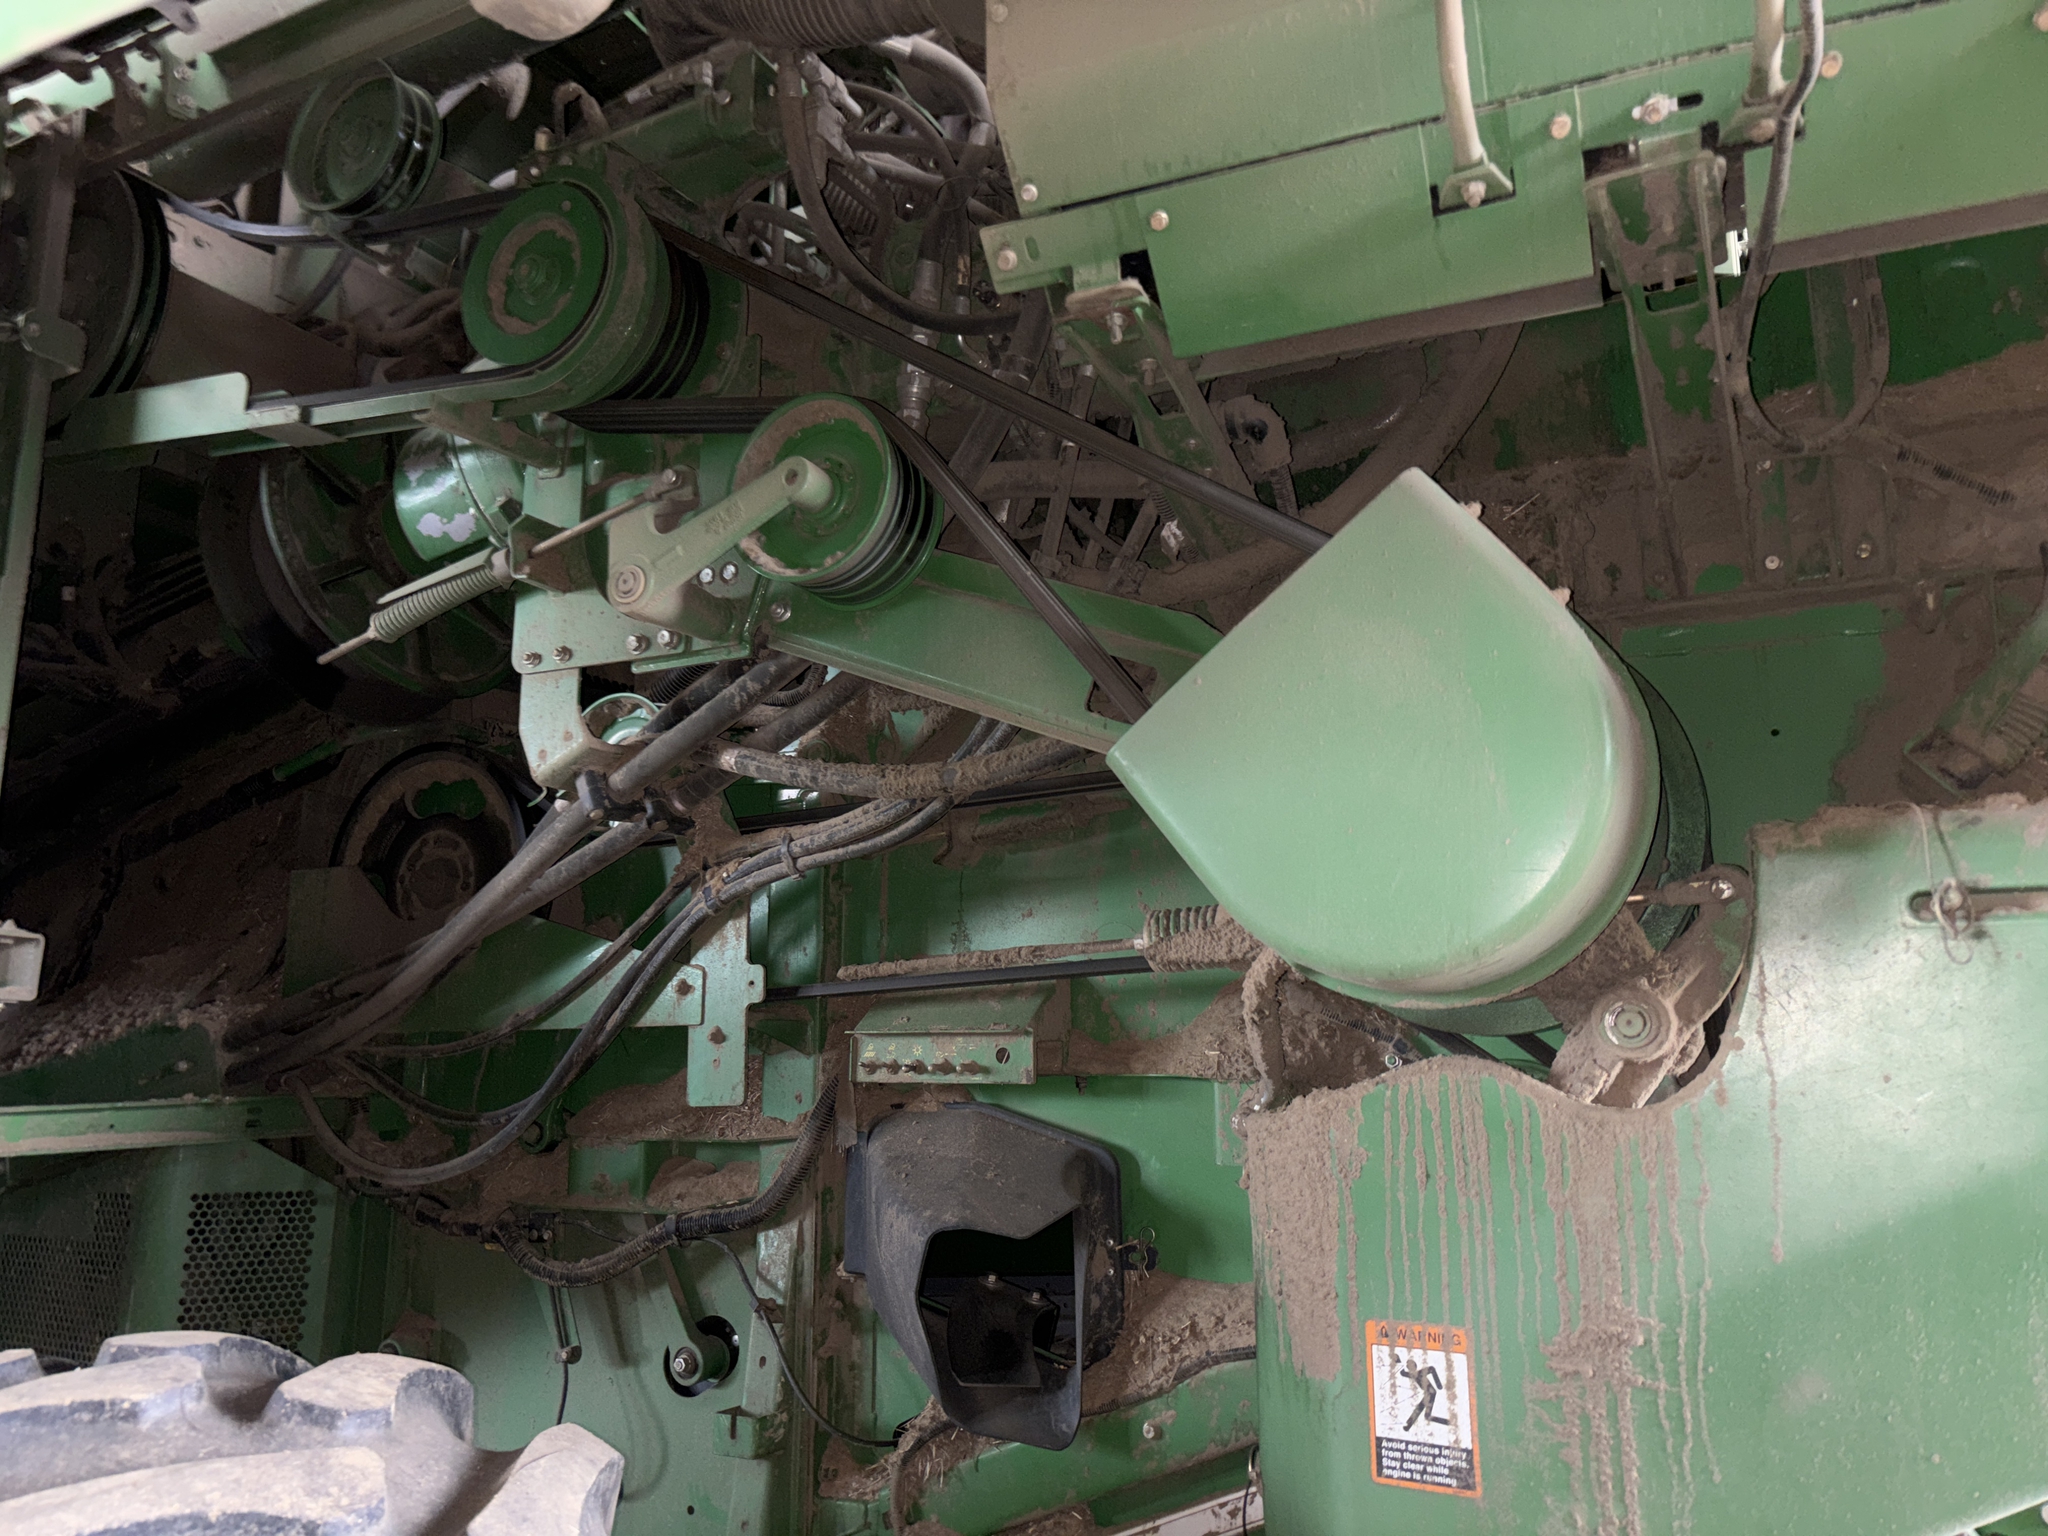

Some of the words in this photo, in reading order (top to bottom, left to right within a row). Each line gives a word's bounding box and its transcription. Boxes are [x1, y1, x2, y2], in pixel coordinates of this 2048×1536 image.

[1381, 1439, 1405, 1450] Avoid
[1407, 1443, 1440, 1455] serious
[1381, 1448, 1401, 1457] from
[1403, 1451, 1433, 1463] thrown
[1381, 1457, 1401, 1469] Stay
[1402, 1460, 1425, 1471] clear
[1426, 1464, 1449, 1475] while
[1382, 1468, 1411, 1479] engine
[1412, 1471, 1421, 1480] is
[1423, 1475, 1457, 1487] running
